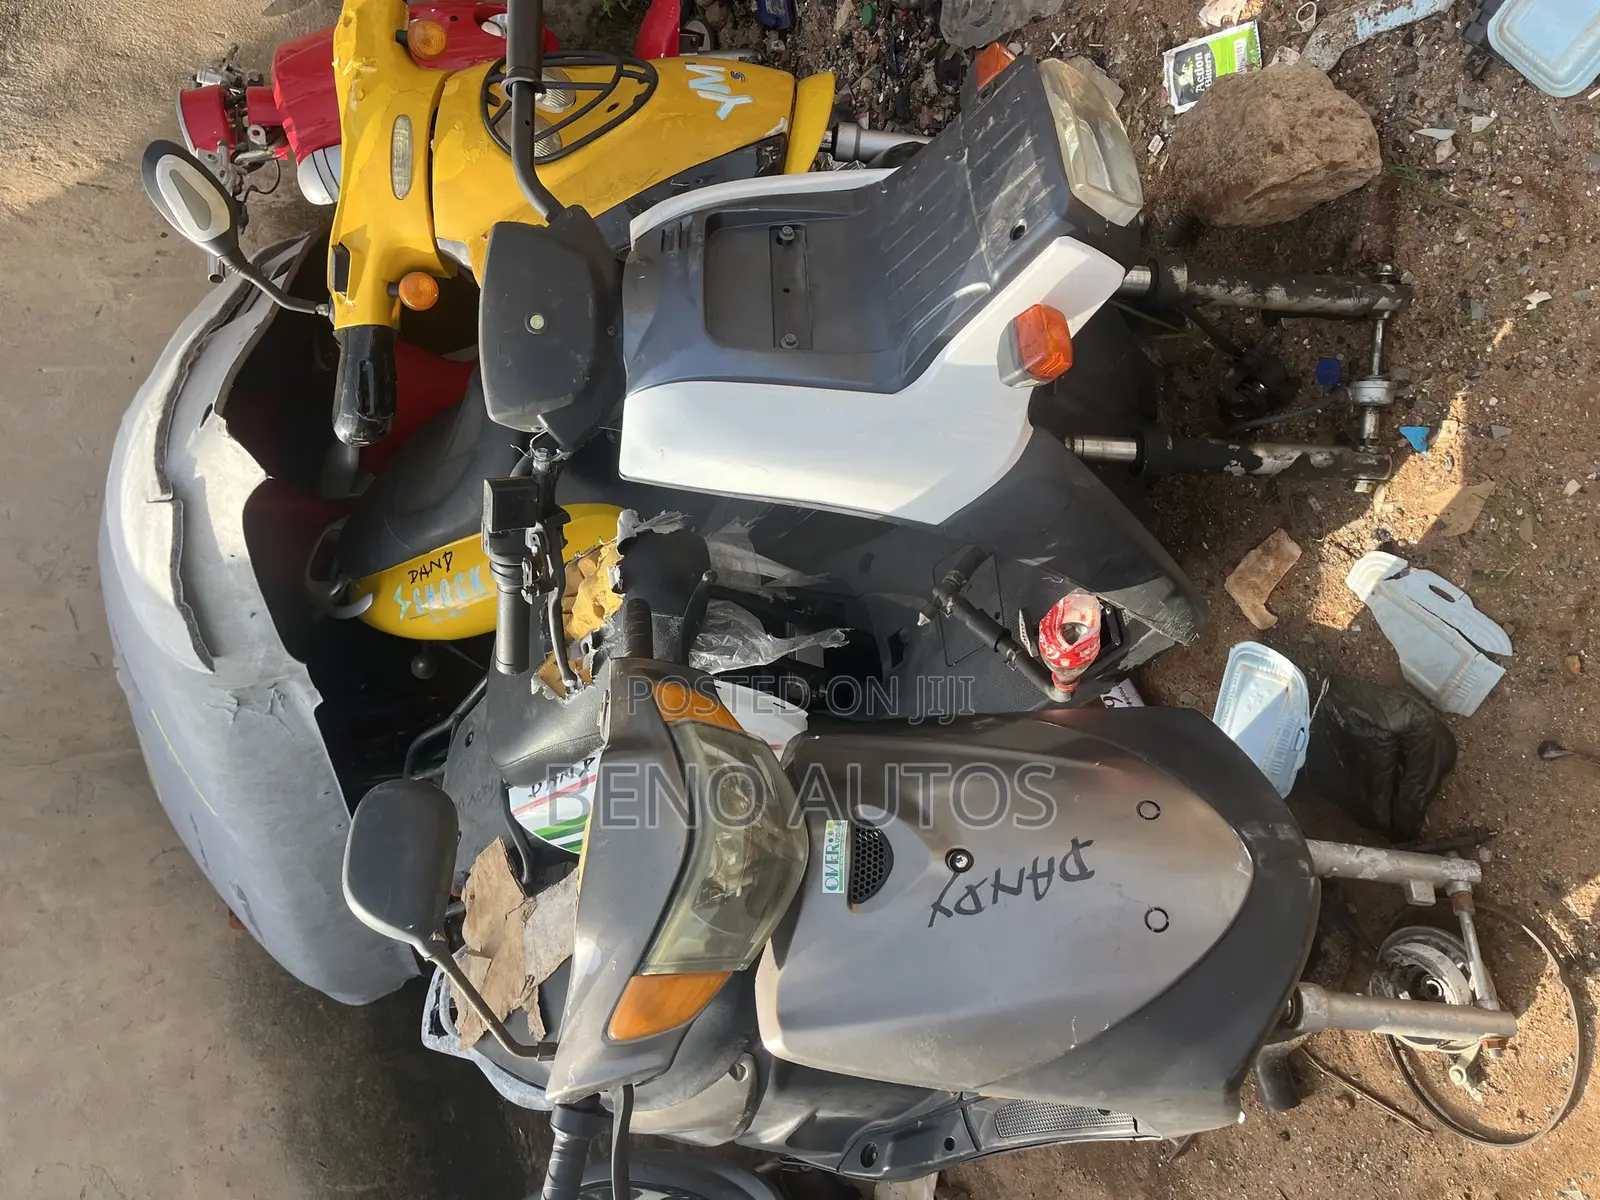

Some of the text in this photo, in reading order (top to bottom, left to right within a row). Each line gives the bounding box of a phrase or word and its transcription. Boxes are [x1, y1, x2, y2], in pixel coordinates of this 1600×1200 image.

[1193, 51, 1205, 94] Action
[1204, 52, 1213, 88] Bitters
[413, 565, 485, 613] SHOCK
[824, 844, 840, 891] OVER
[927, 835, 1095, 928] DANDY
